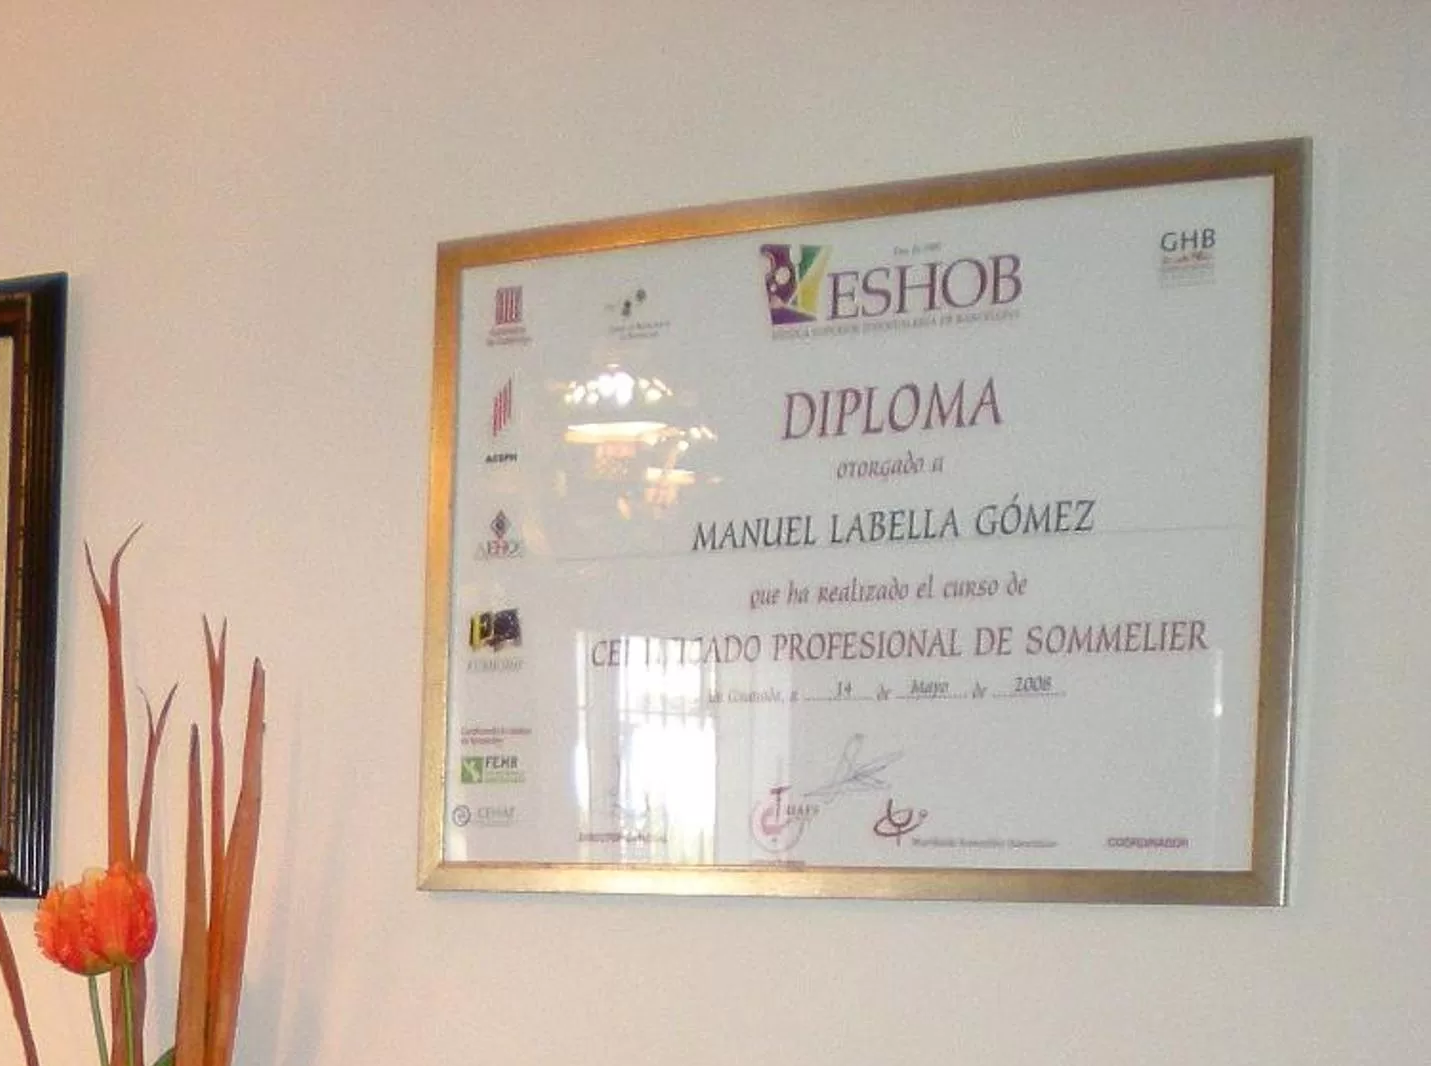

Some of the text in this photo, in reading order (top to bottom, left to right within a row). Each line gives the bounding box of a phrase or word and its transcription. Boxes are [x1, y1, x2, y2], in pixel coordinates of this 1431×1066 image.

[1161, 228, 1216, 252] GHB
[827, 254, 1023, 320] ESHOB
[781, 375, 1005, 440] DIPLOMA
[836, 450, 924, 481] otorgado
[692, 493, 1096, 551] MANUEL LABELLA GÓMEZ
[750, 590, 781, 609] que
[787, 581, 809, 606] ha
[917, 574, 935, 599] el
[943, 576, 1000, 599] curso
[1006, 571, 1029, 596] de
[773, 627, 963, 662] PROFESIONAL
[975, 626, 1014, 656] DE
[1025, 619, 1209, 656] SOMMELIER
[836, 681, 852, 697] 14
[1014, 676, 1053, 692] 2008
